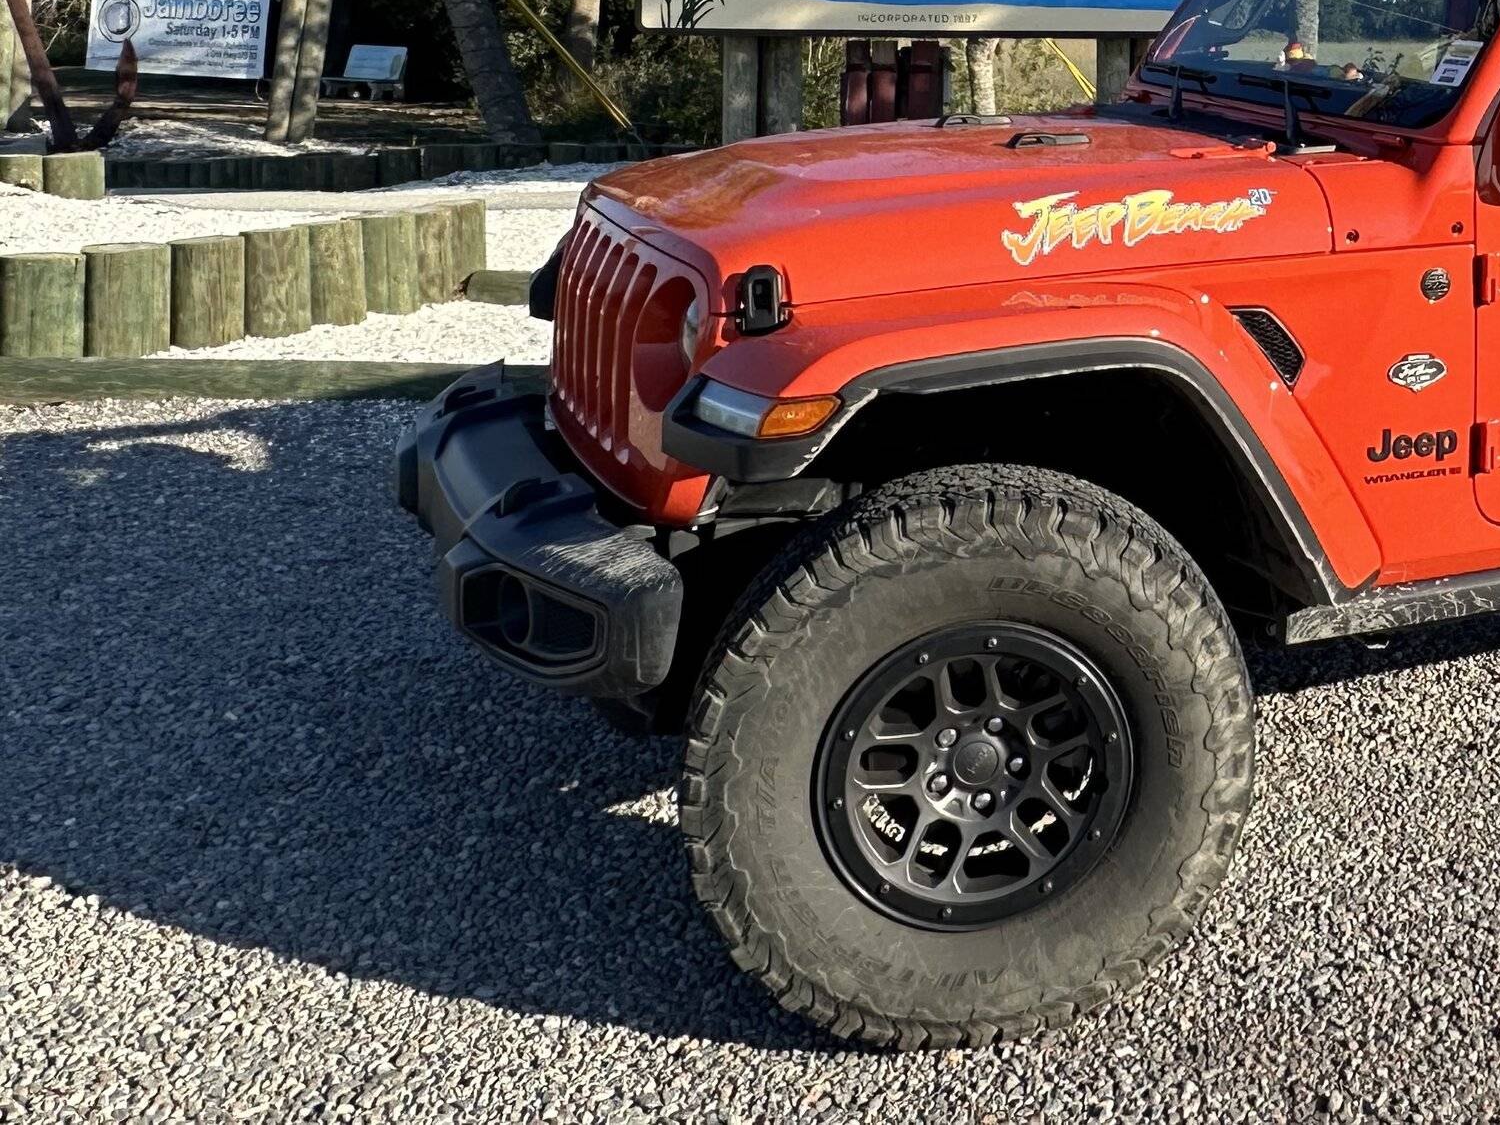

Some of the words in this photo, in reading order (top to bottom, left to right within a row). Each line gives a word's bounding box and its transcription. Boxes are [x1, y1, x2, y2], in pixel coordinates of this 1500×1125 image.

[857, 13, 950, 24] INCORPORATED
[165, 22, 217, 40] Saturday
[1366, 428, 1458, 463] Jeep
[1363, 468, 1447, 485] WRANGLER
